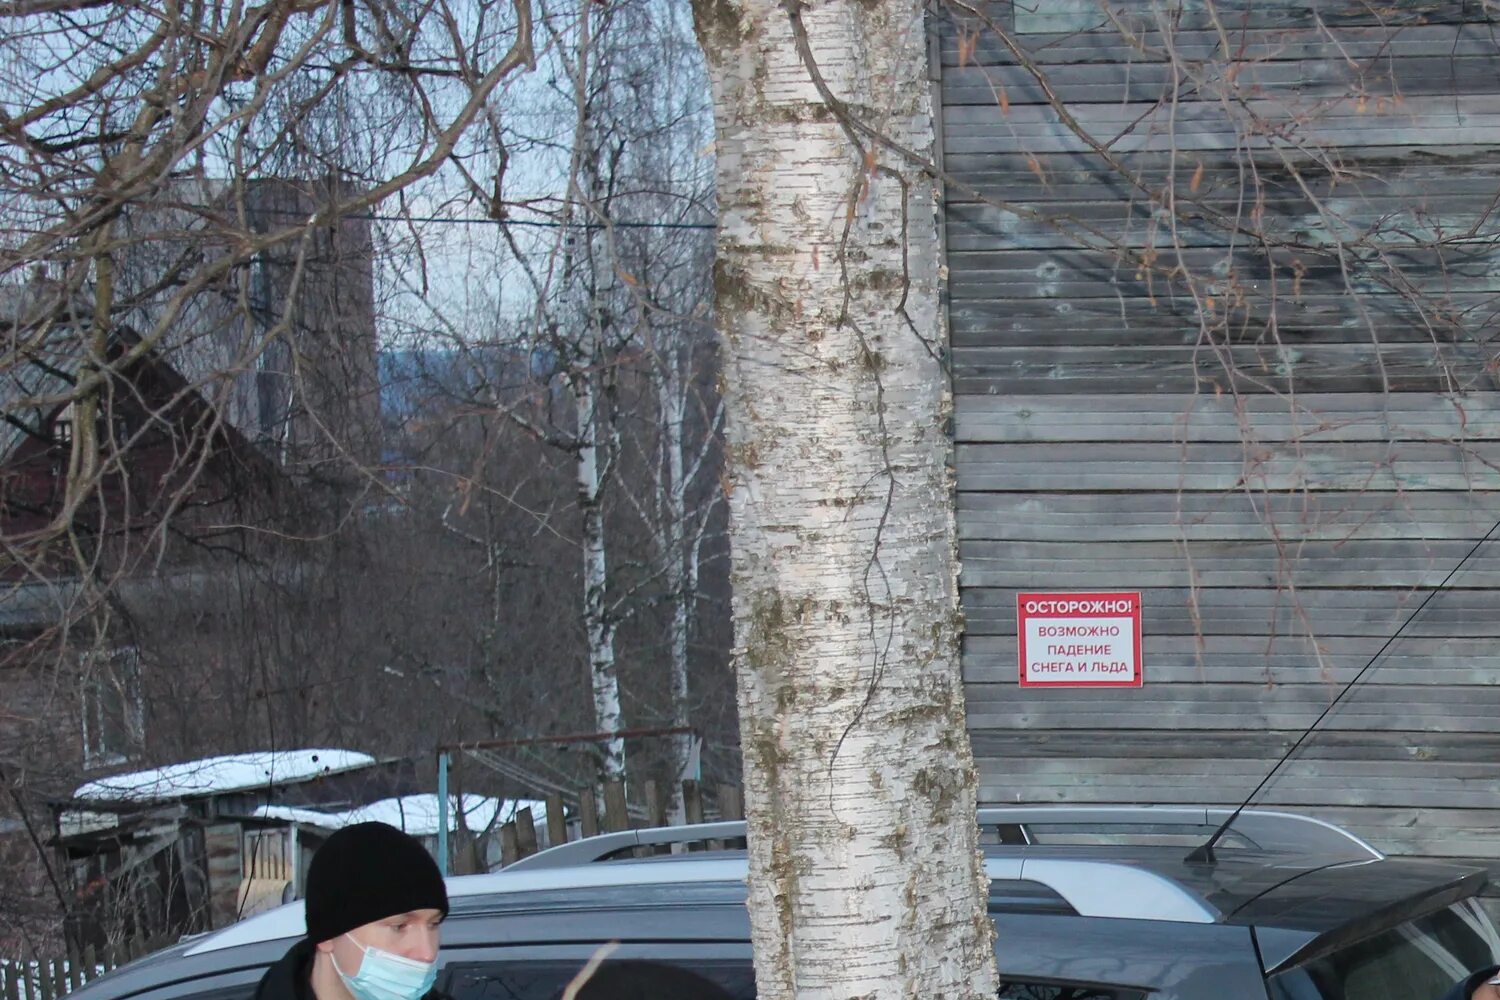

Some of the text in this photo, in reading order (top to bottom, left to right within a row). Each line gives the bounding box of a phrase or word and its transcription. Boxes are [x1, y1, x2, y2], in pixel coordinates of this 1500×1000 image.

[1026, 600, 1132, 613] ОСТОРОЖНО!
[1038, 626, 1120, 637] ВОЗМОЖНО
[1047, 645, 1112, 656] ПАДЕНИЕ
[1031, 662, 1128, 673] СНЕГА И ЛЬДА
